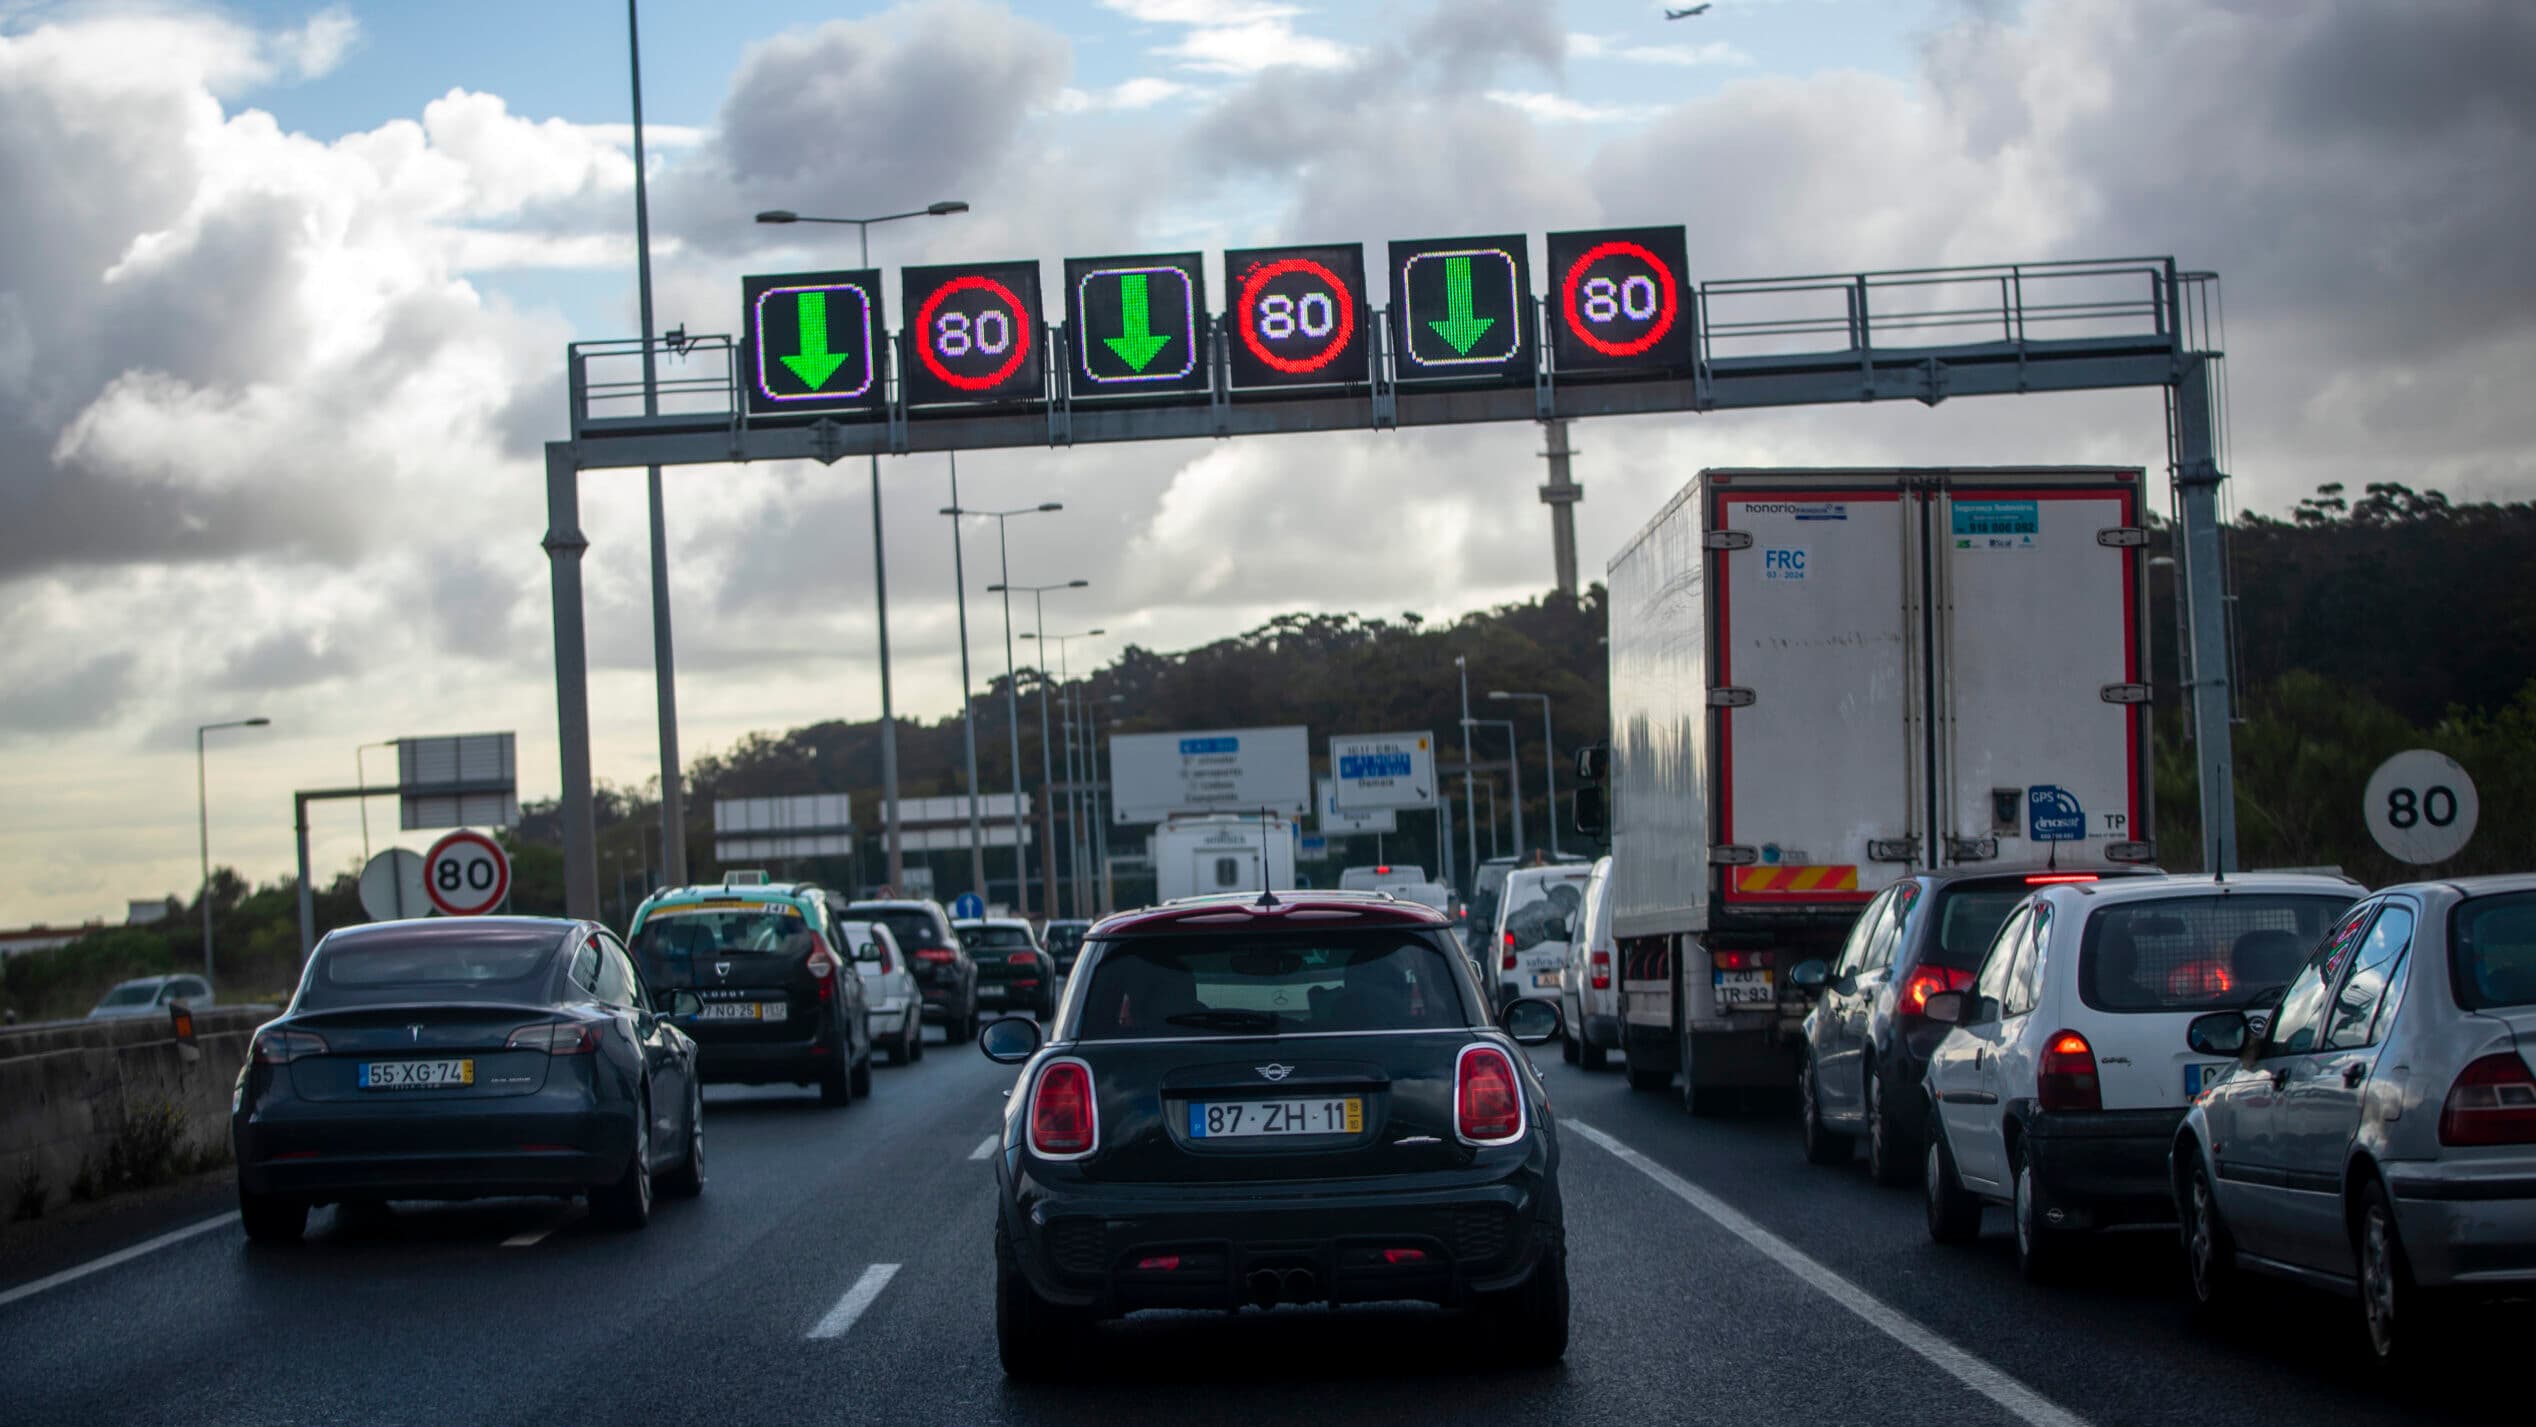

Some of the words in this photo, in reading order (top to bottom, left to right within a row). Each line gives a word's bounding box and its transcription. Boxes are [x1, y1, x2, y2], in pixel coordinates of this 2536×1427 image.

[1258, 292, 1333, 340] 80
[1583, 275, 1657, 323] 80
[936, 310, 1010, 357] 80
[1766, 550, 1805, 569] FRC
[2032, 791, 2055, 804] GPS
[2388, 785, 2458, 829] 80
[2104, 814, 2126, 829] TP
[438, 858, 494, 892] 80
